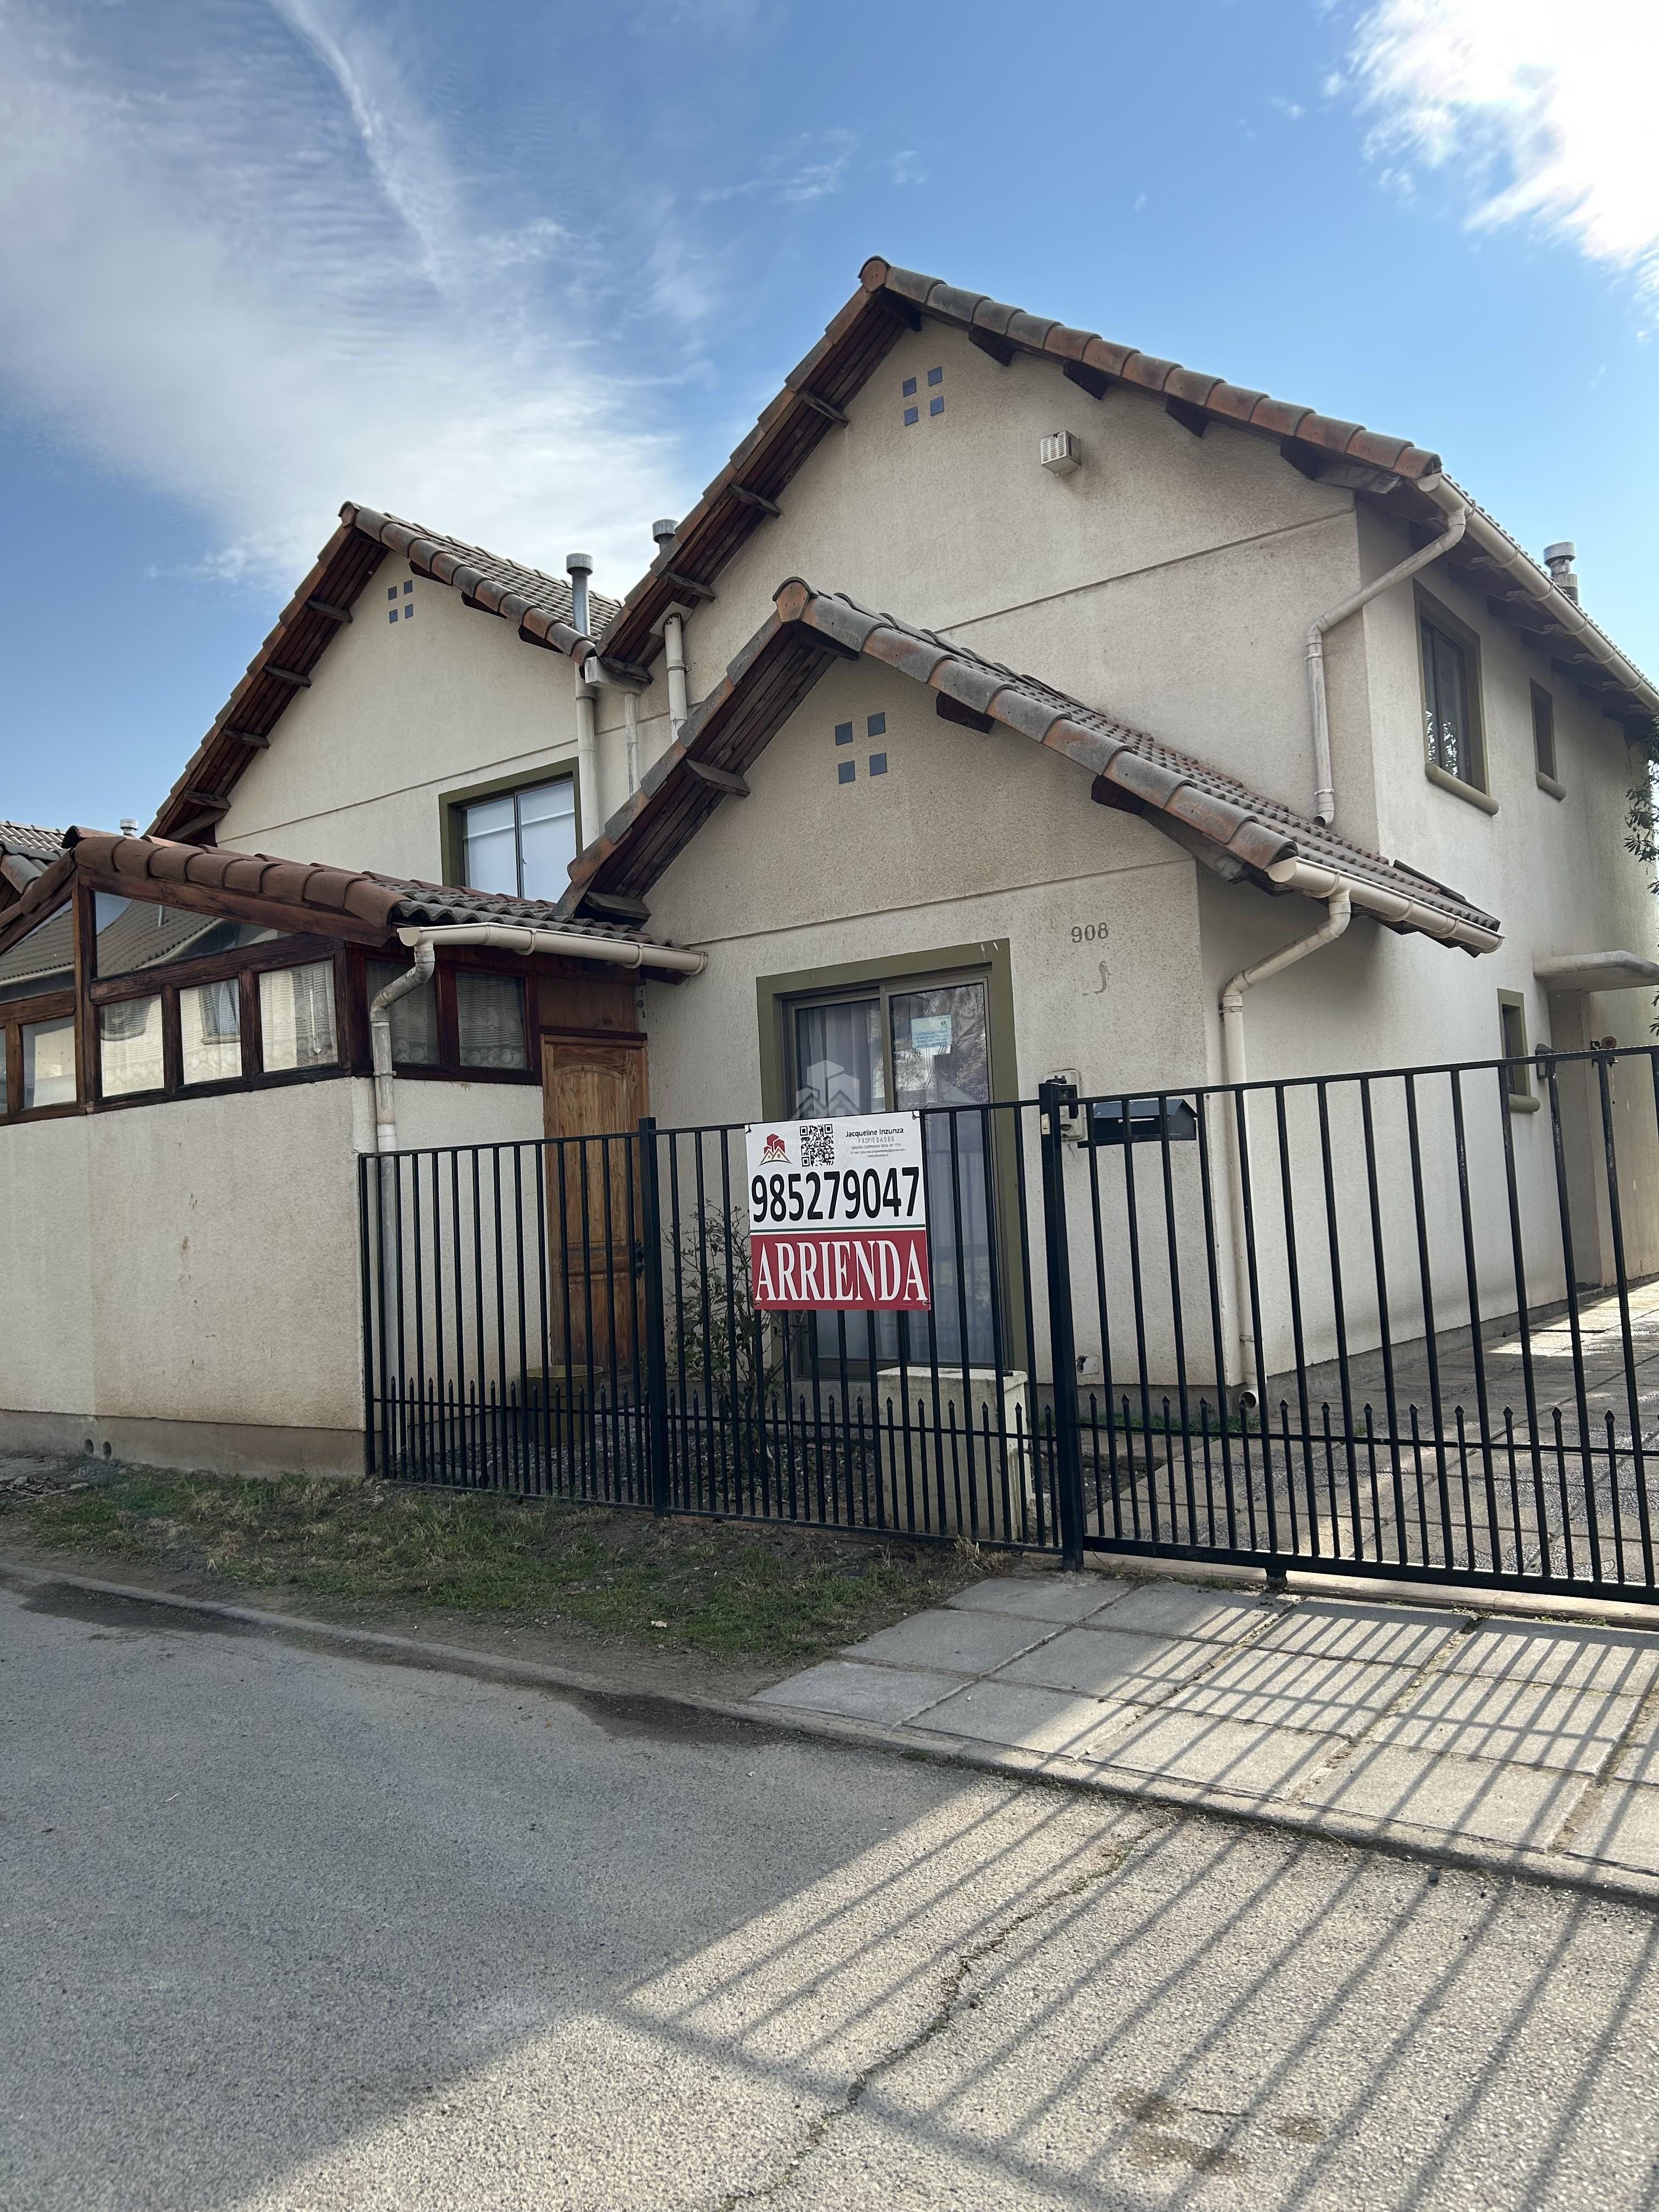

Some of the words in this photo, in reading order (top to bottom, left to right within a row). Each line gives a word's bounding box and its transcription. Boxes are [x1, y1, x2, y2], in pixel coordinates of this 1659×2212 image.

[1071, 923, 1109, 943] 908
[845, 1130, 878, 1138] Jacqueline
[752, 1166, 919, 1223] 985279047
[755, 1238, 928, 1302] ARRIENDA
